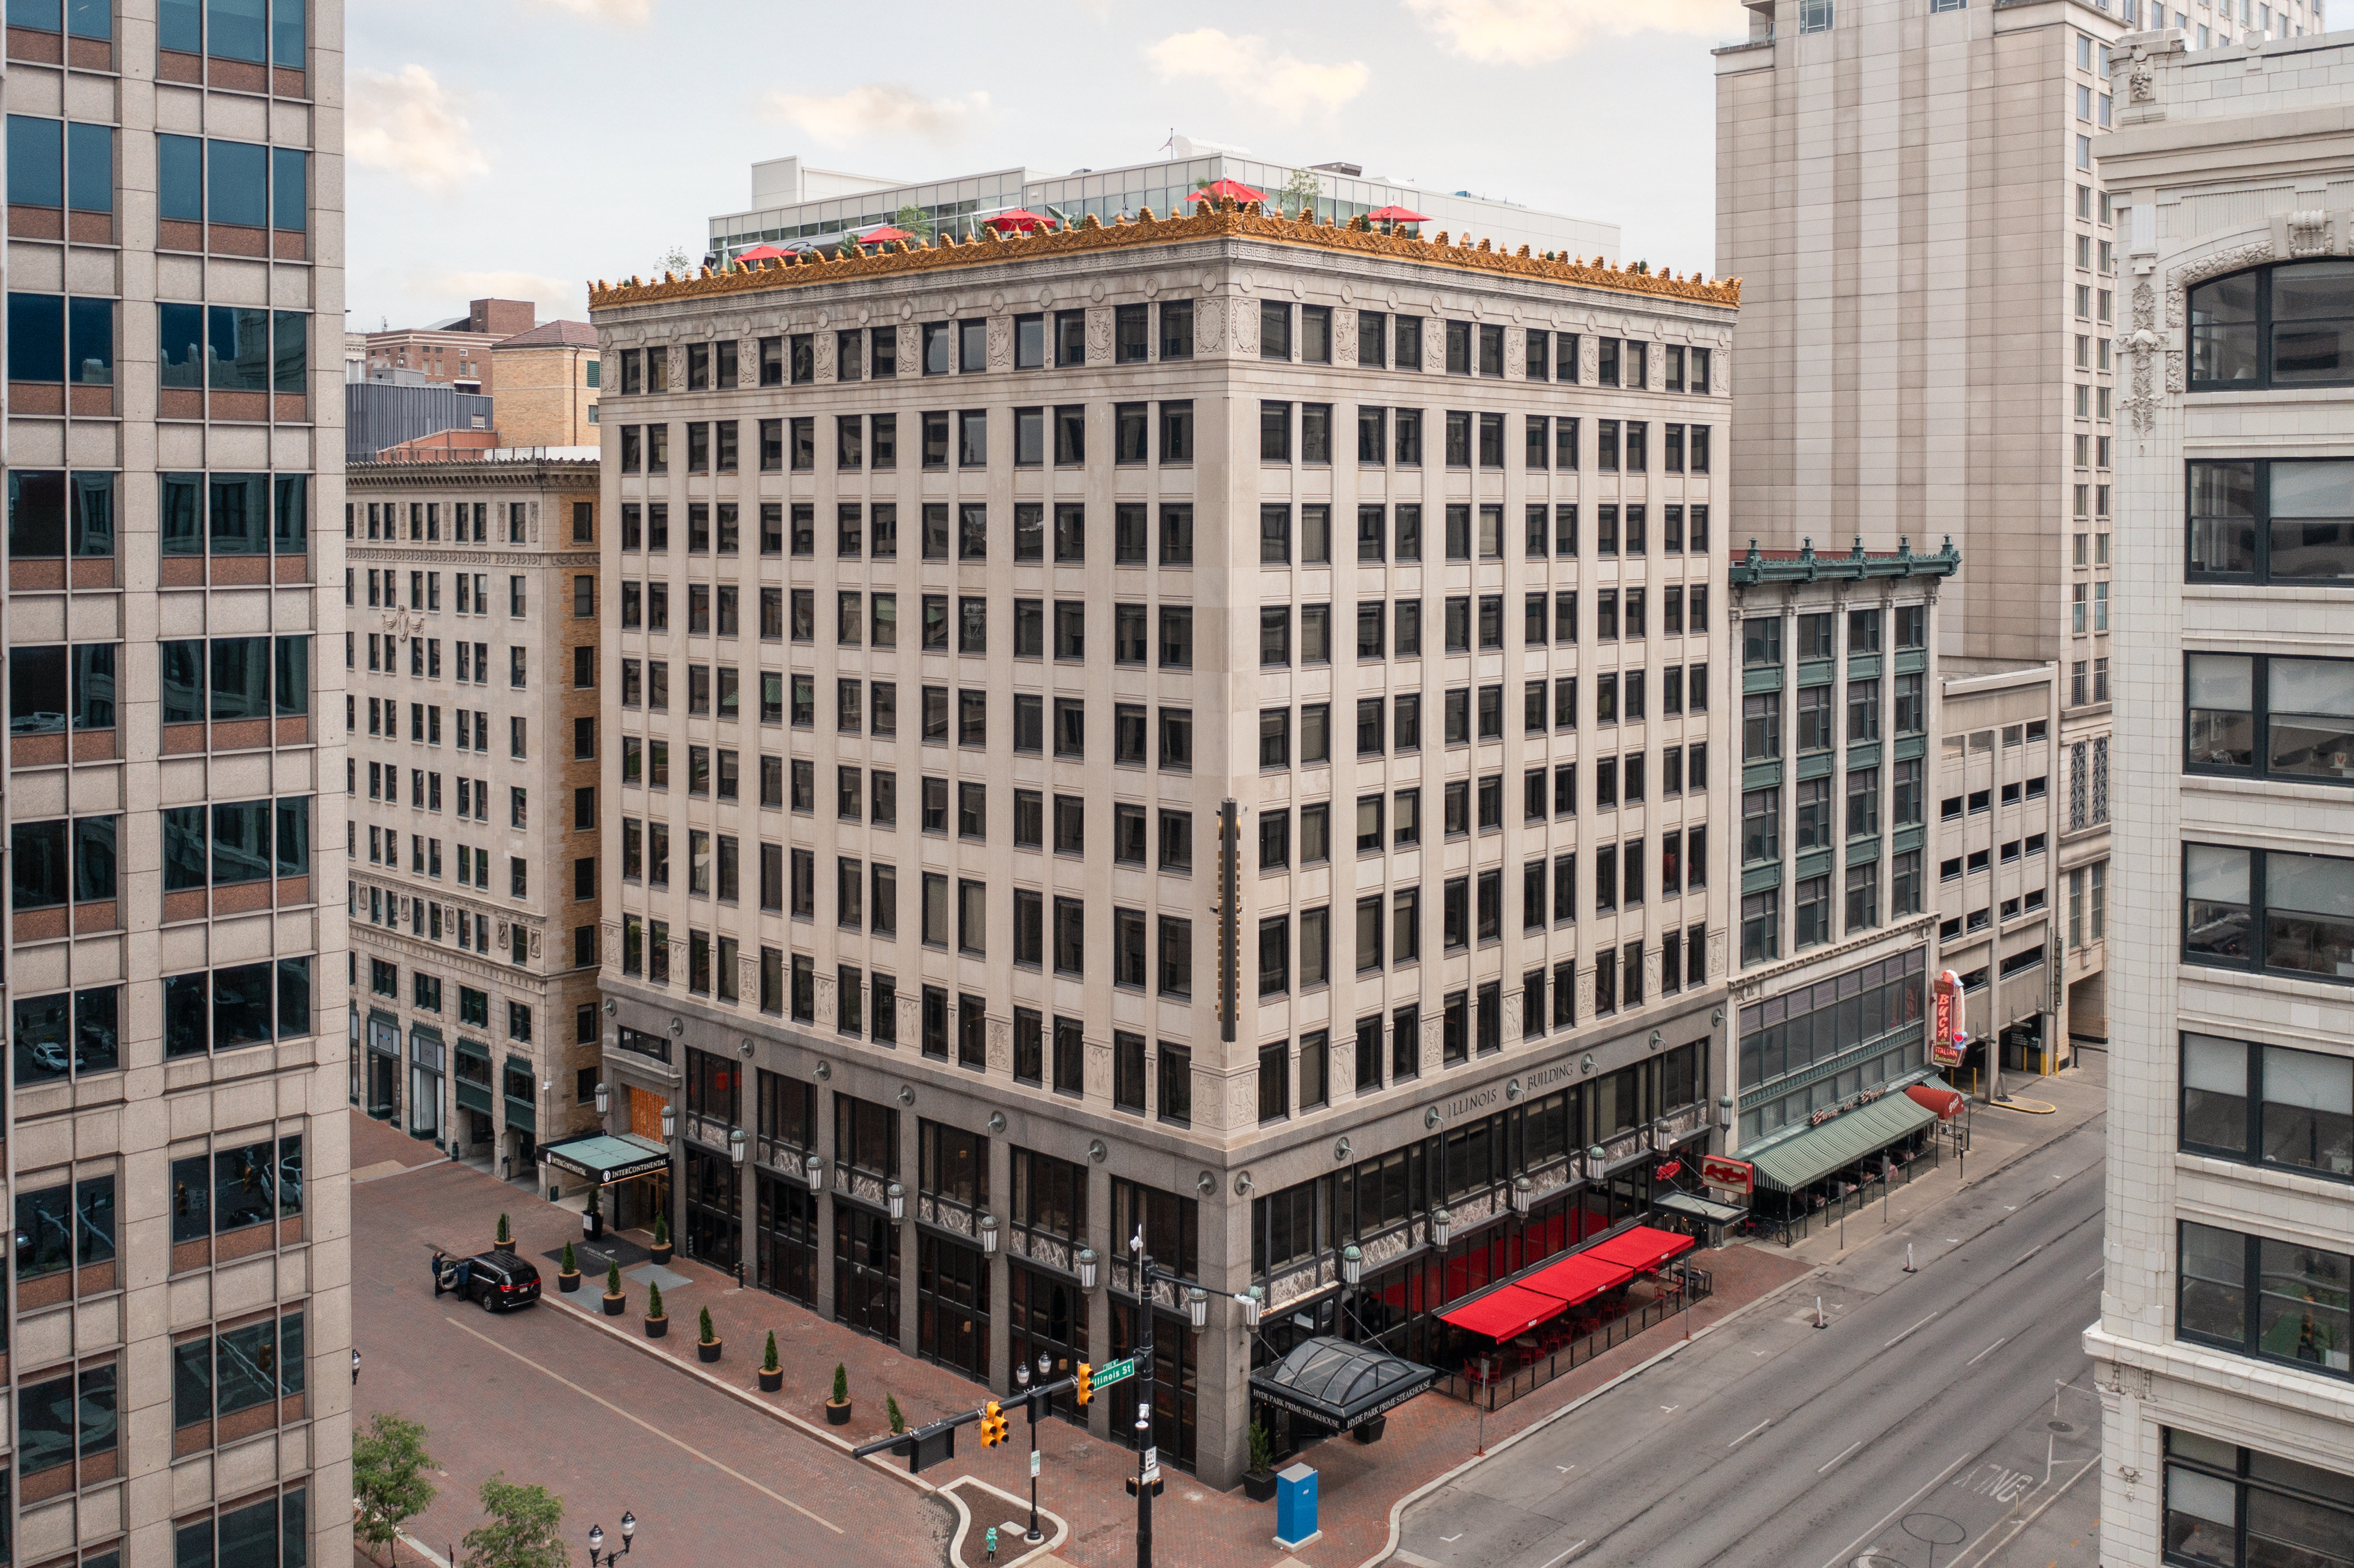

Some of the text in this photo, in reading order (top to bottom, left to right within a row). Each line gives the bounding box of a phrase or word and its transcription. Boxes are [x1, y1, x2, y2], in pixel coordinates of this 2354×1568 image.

[1938, 994, 1949, 1038] BUCA
[1935, 1047, 1957, 1057] ITALIAN
[1448, 1063, 1573, 1118] ILLINOIS BUILDING
[1812, 1086, 1889, 1125] Buca di Beppo
[1122, 1364, 1131, 1375] St
[1254, 1389, 1340, 1428] HYDE PARK PRIME STEAKHOUSE
[1347, 1379, 1431, 1429] HYDE PARK PRIME STEAKHOUSE
[1147, 1449, 1155, 1457] ONE
